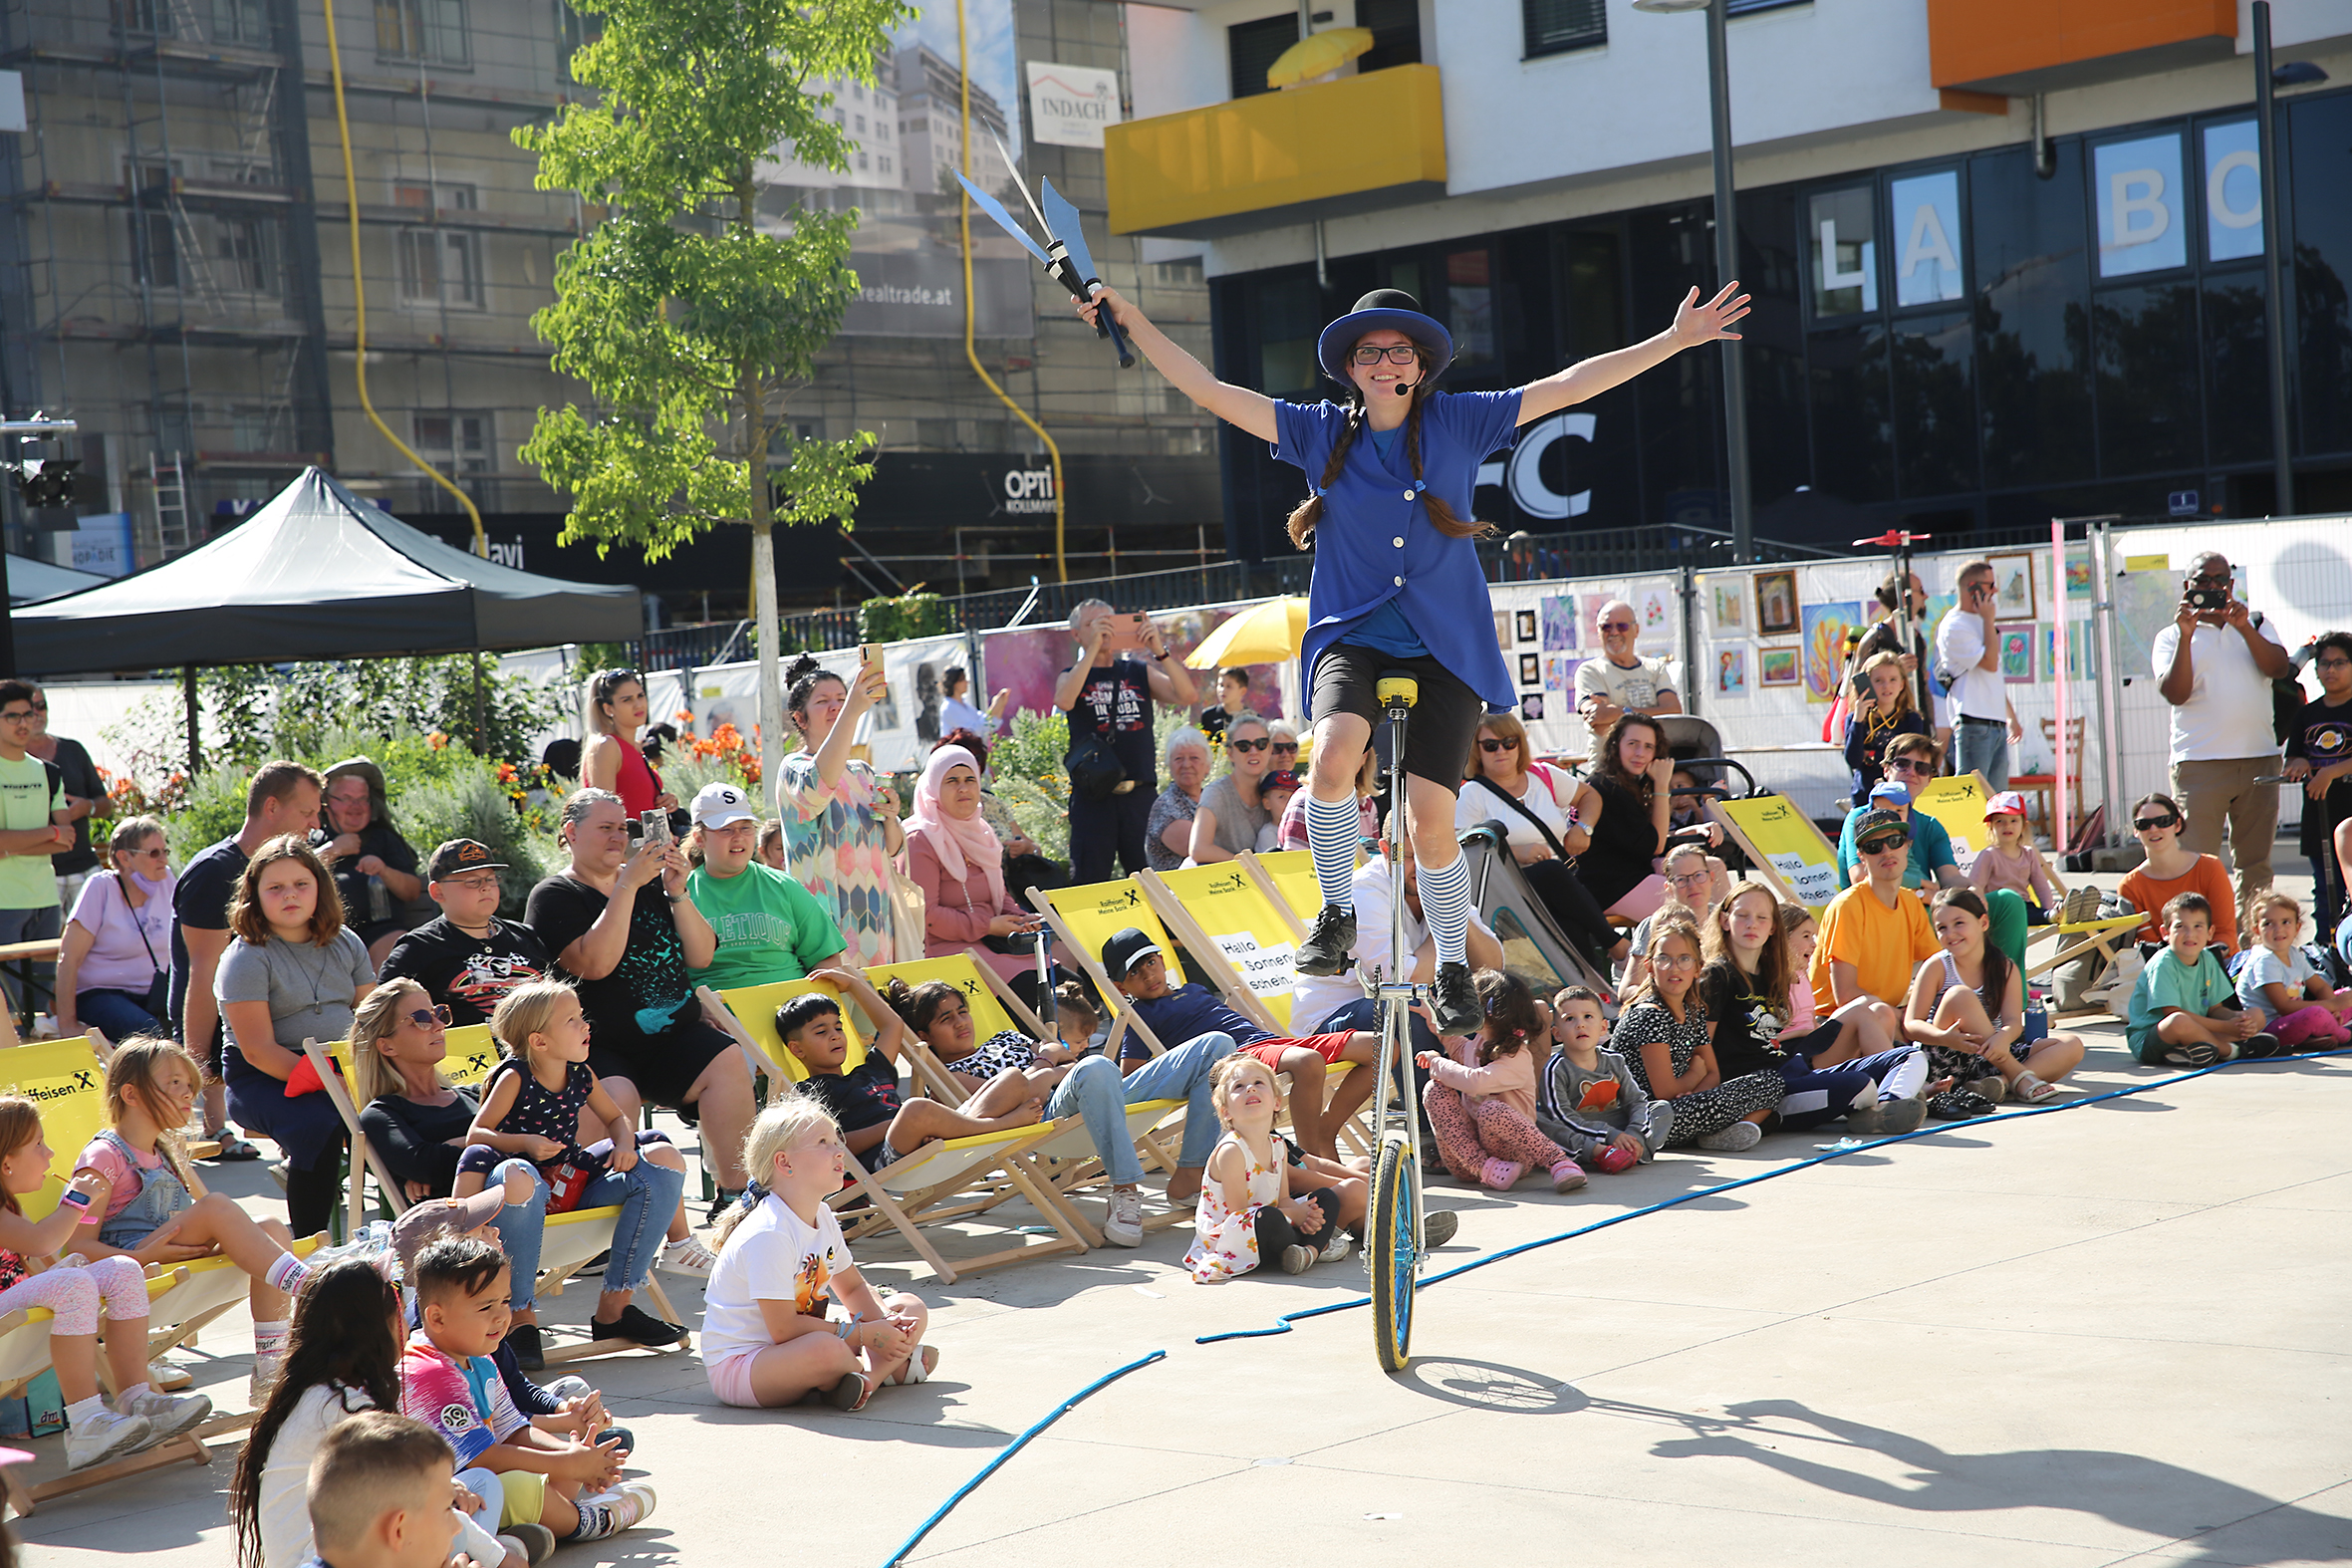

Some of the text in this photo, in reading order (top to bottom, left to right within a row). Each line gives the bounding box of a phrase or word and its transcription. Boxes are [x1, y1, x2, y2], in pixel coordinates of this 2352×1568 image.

[1041, 97, 1107, 121] INDACH
[1095, 701, 1141, 715] IN UBA
[722, 791, 736, 804] S
[1221, 941, 1256, 954] Hallo
[1249, 974, 1293, 990] schein.
[40, 1410, 60, 1424] dm
